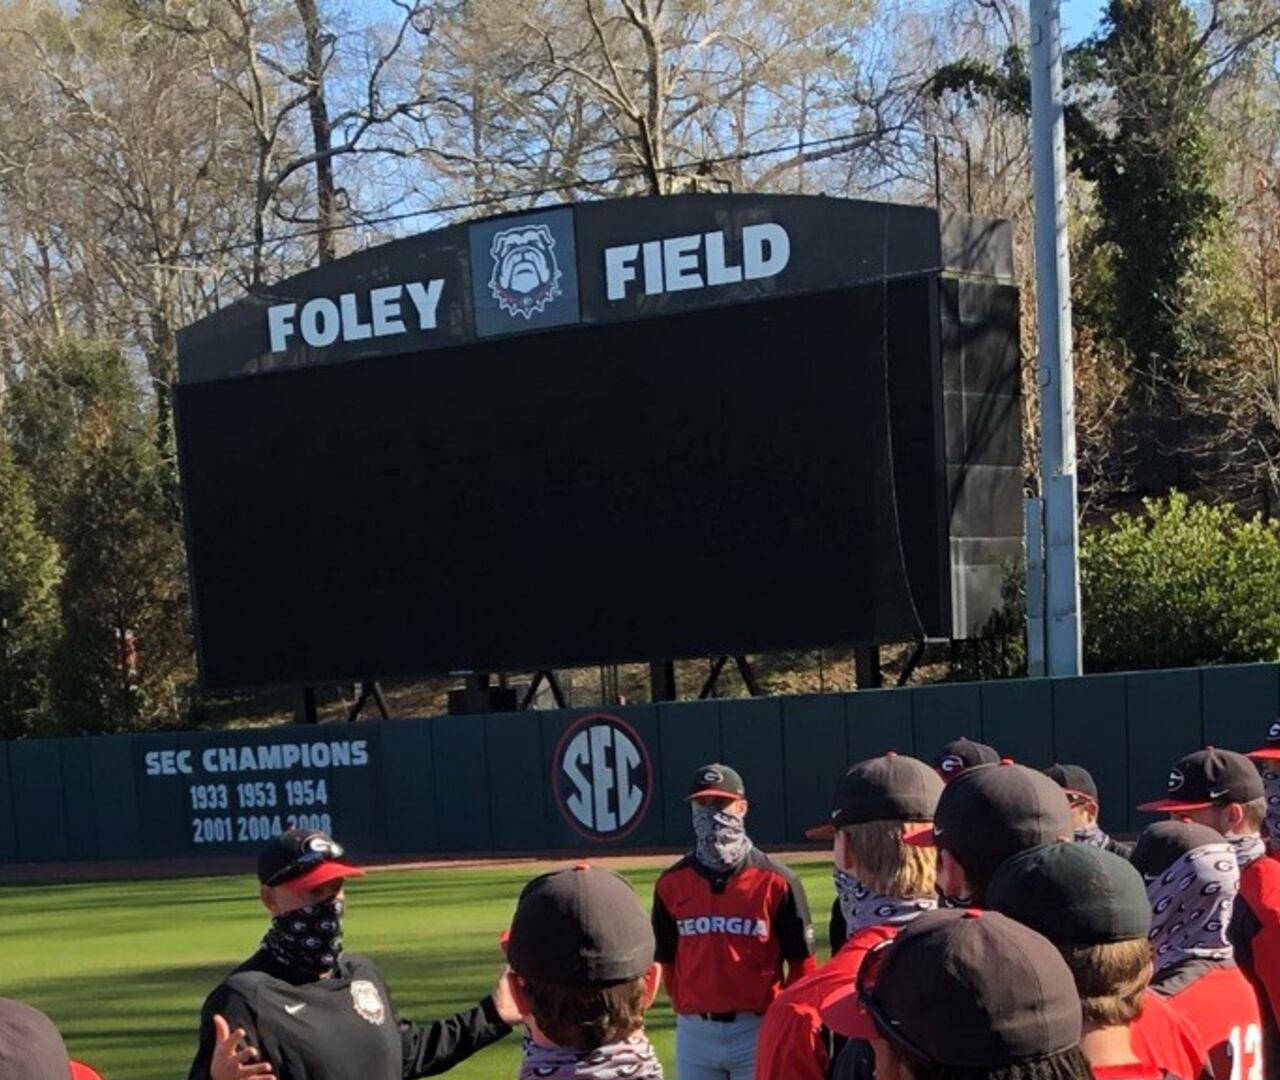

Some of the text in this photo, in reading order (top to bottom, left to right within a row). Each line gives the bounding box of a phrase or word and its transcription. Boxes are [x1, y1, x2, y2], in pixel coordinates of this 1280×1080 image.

[268, 222, 791, 353] FOLEY FIELD
[145, 740, 369, 775] SEC CHAMPIONS
[190, 779, 328, 810] 1933 1953 1954
[562, 725, 644, 832] SEC
[192, 817, 233, 843] 2001
[238, 815, 283, 841] 2004
[676, 915, 769, 943] GEORGIA
